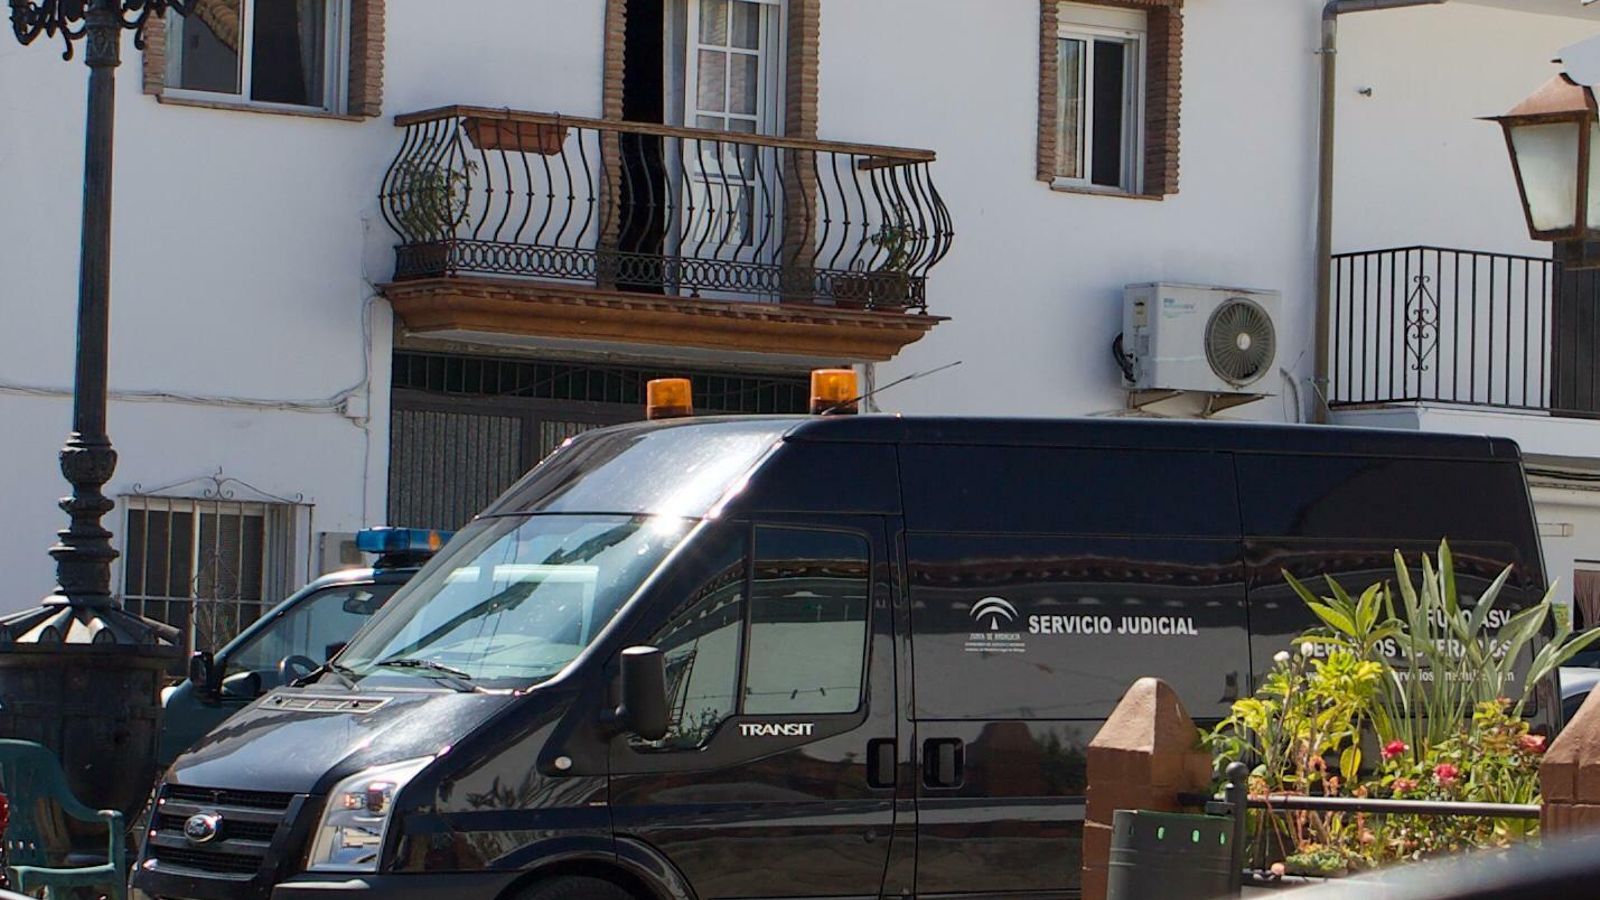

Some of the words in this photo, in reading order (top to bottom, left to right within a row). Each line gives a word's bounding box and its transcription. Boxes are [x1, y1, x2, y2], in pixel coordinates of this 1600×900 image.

[1028, 615, 1112, 634] SERVICIO
[1117, 616, 1199, 636] JUDICIAL
[738, 722, 815, 736] TRANSIT
